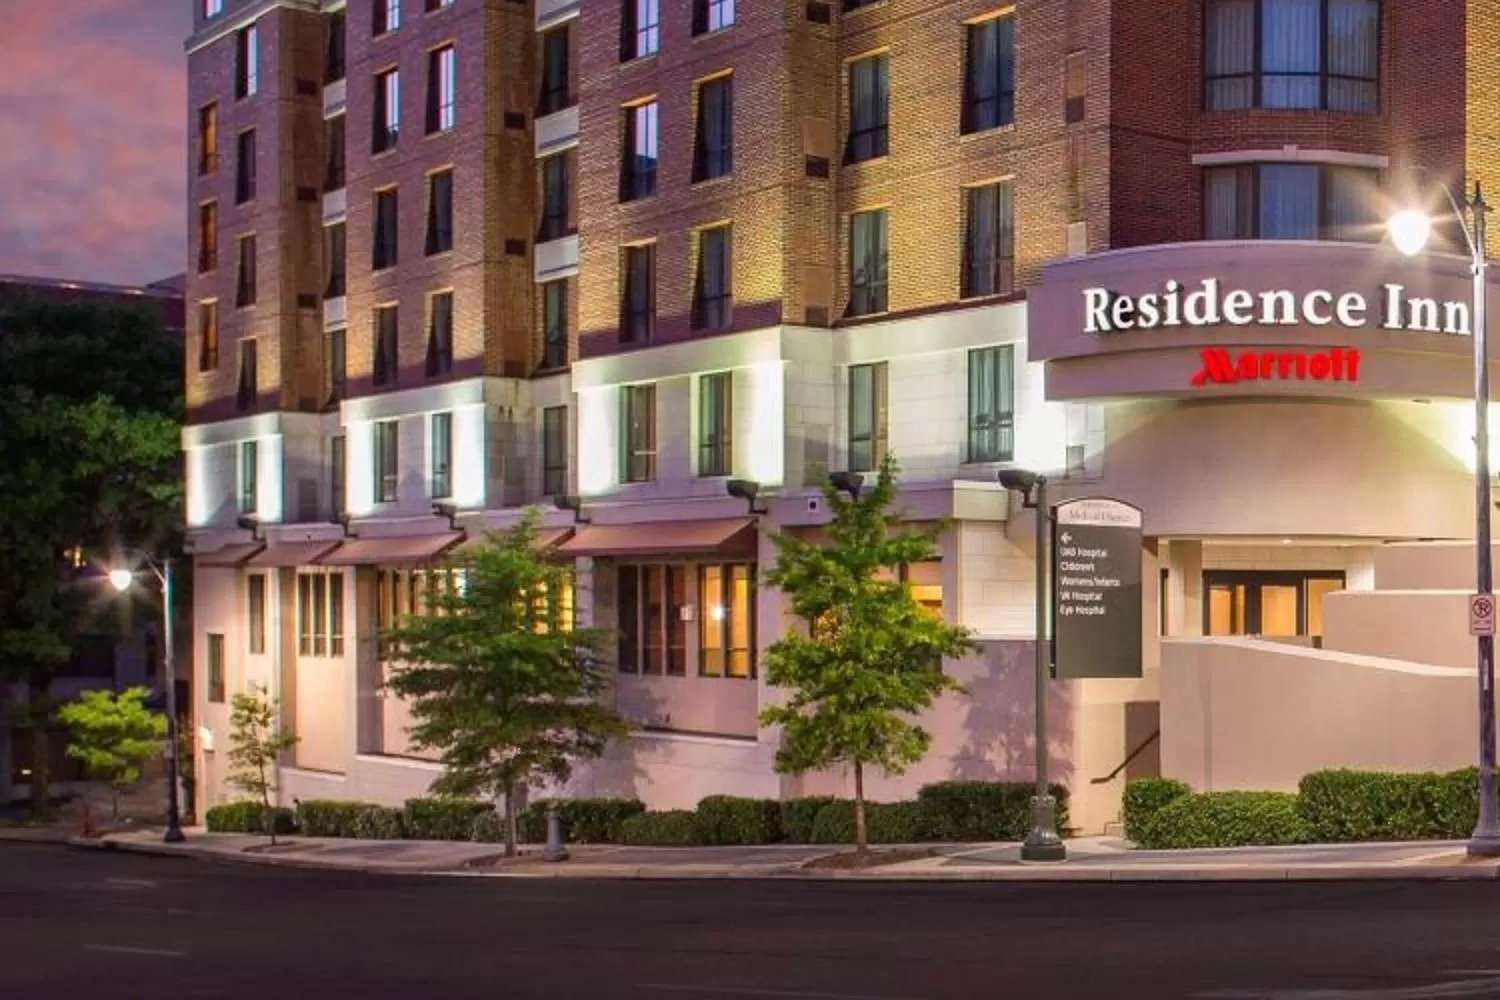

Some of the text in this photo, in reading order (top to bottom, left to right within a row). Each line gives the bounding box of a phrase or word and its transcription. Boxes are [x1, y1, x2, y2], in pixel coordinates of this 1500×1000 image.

[1082, 278, 1472, 336] Residence Inn
[1191, 346, 1361, 387] Marriott
[1060, 603, 1106, 616] Eye Hospital
[1071, 592, 1103, 603] Hospital
